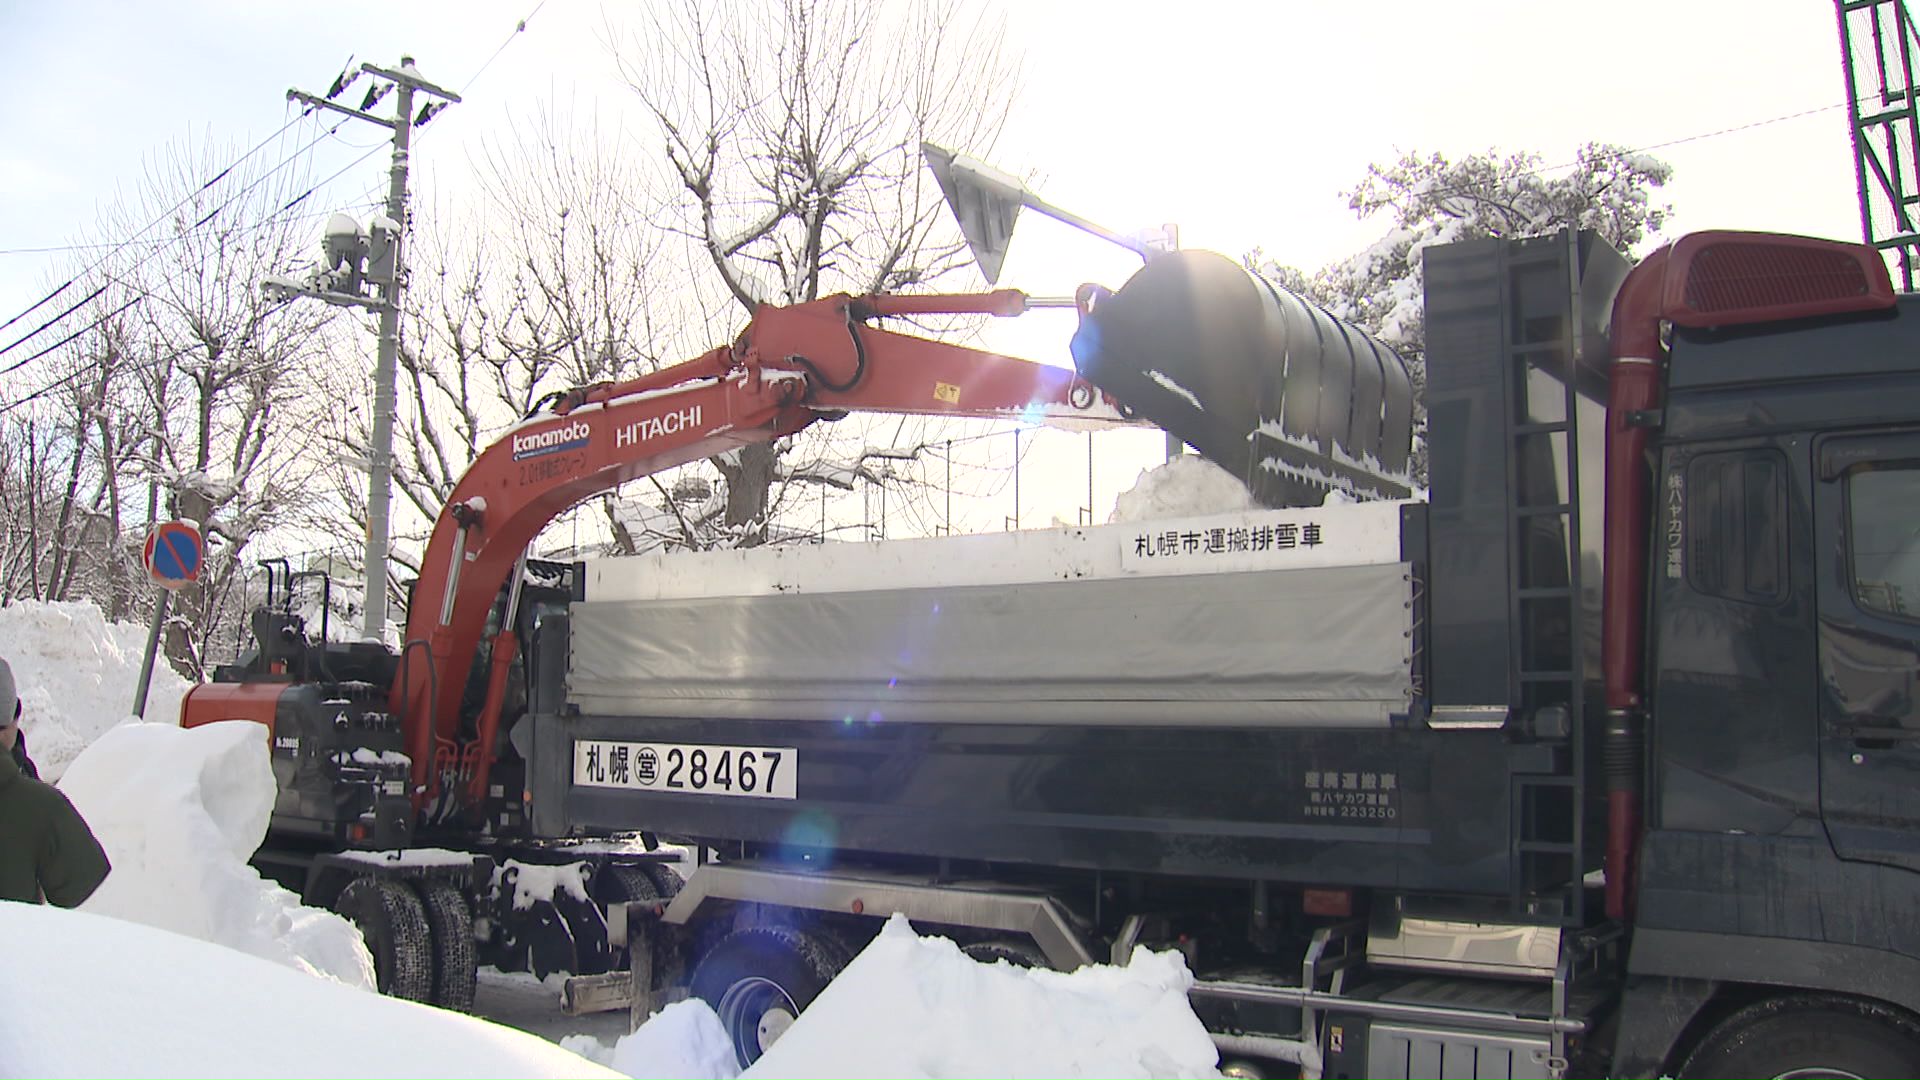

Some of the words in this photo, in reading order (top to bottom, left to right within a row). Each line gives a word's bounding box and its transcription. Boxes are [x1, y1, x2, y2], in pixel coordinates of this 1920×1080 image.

[512, 420, 591, 454] kanamoto
[615, 405, 702, 449] HITACHI
[1134, 521, 1325, 558] 札幌市運搬排雪車
[1341, 806, 1396, 818] 223250
